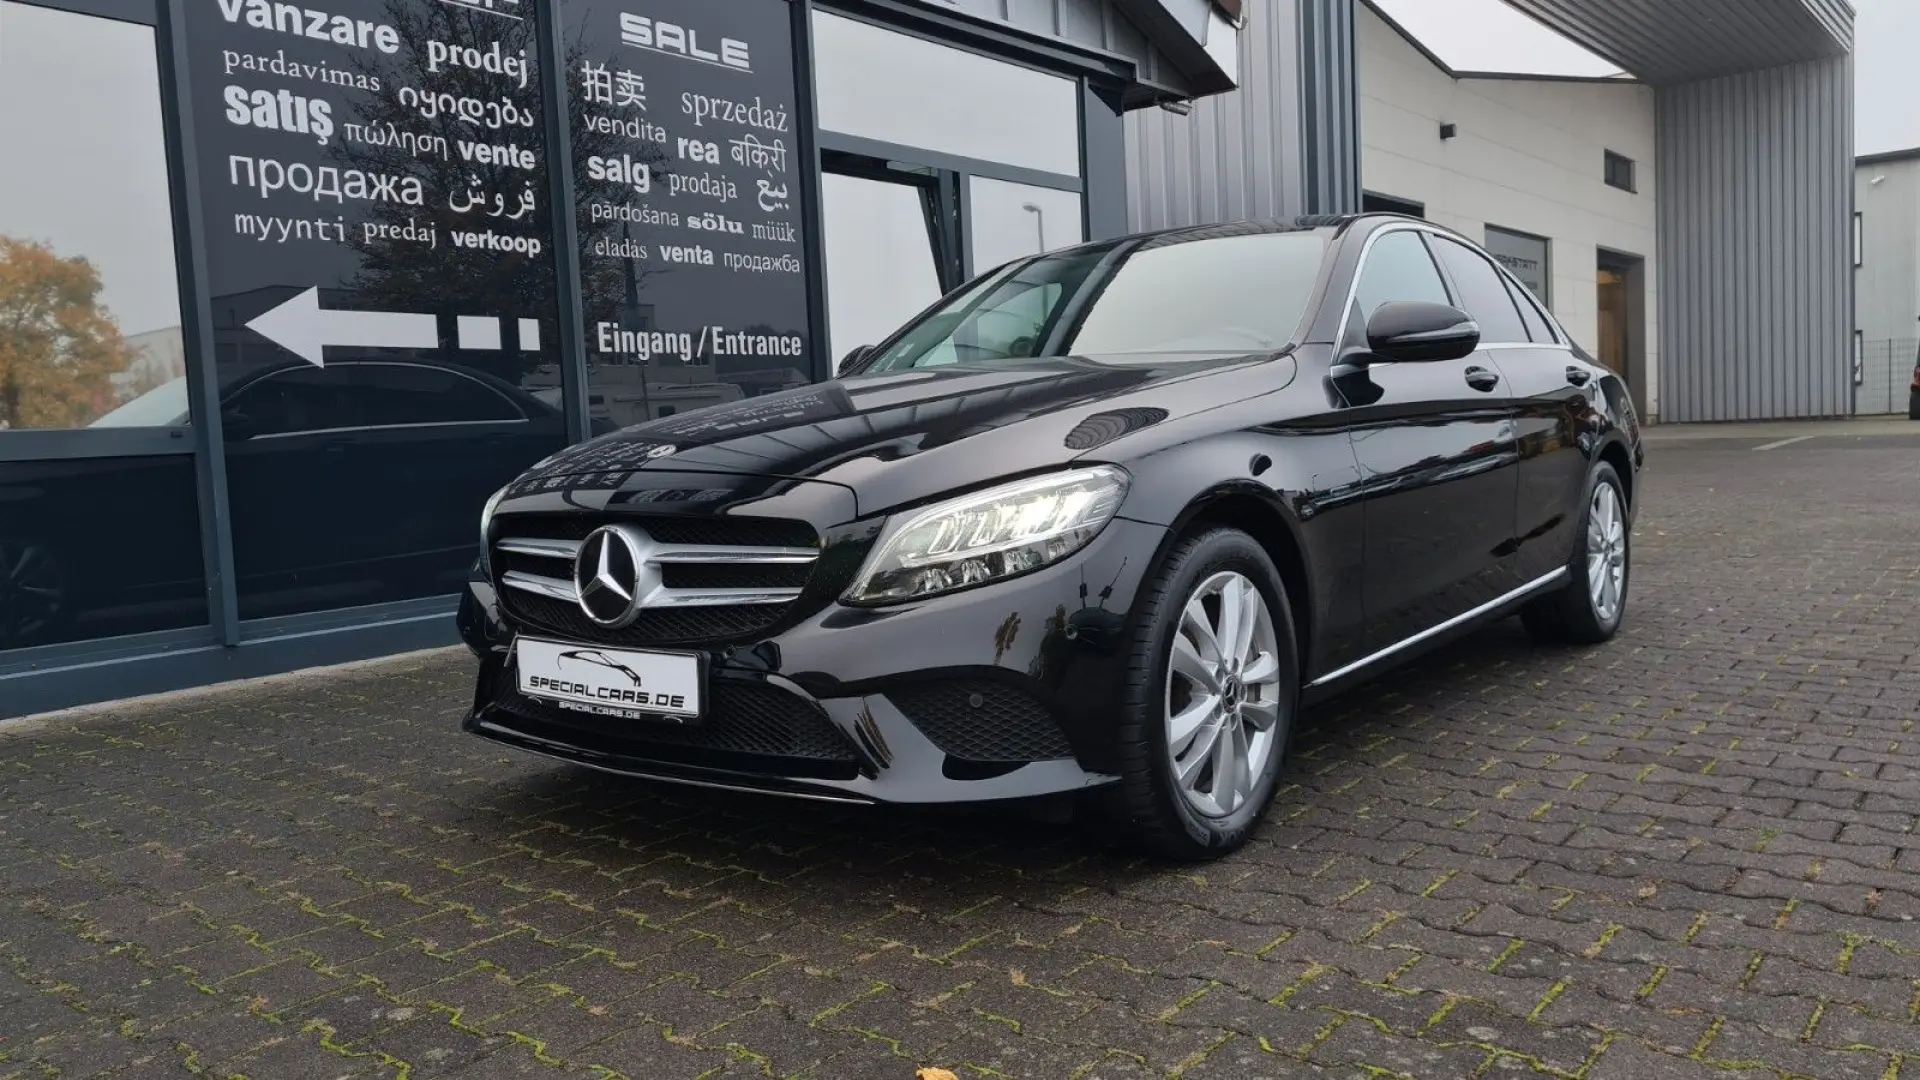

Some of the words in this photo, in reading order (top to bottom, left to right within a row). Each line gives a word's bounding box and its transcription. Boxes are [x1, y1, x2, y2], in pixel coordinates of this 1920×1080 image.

[620, 11, 751, 69] SALE
[222, 50, 381, 92] pardavimas
[426, 40, 528, 89] prodej
[580, 60, 647, 111] 拍卖
[223, 84, 334, 146] satış
[583, 113, 667, 143] vendita
[681, 91, 788, 132] sprzedaż
[343, 119, 448, 161] πώληση
[457, 139, 536, 170] vente
[677, 136, 720, 165] rea
[229, 154, 424, 206] продажа
[587, 154, 650, 194] salg
[668, 172, 738, 203] prodaja
[234, 212, 345, 243] myynti
[363, 217, 436, 249] predaj
[451, 229, 541, 258] verkoop
[591, 201, 680, 227] pārdošana
[687, 211, 744, 235] sölu
[751, 220, 797, 243] müük
[595, 236, 648, 260] eladás
[659, 244, 715, 266] venta
[723, 250, 801, 274] продажба
[597, 321, 692, 362] Eingang
[529, 675, 685, 708] SPECIALCARS.DE
[558, 701, 641, 720] SPECIALCARS.DE
